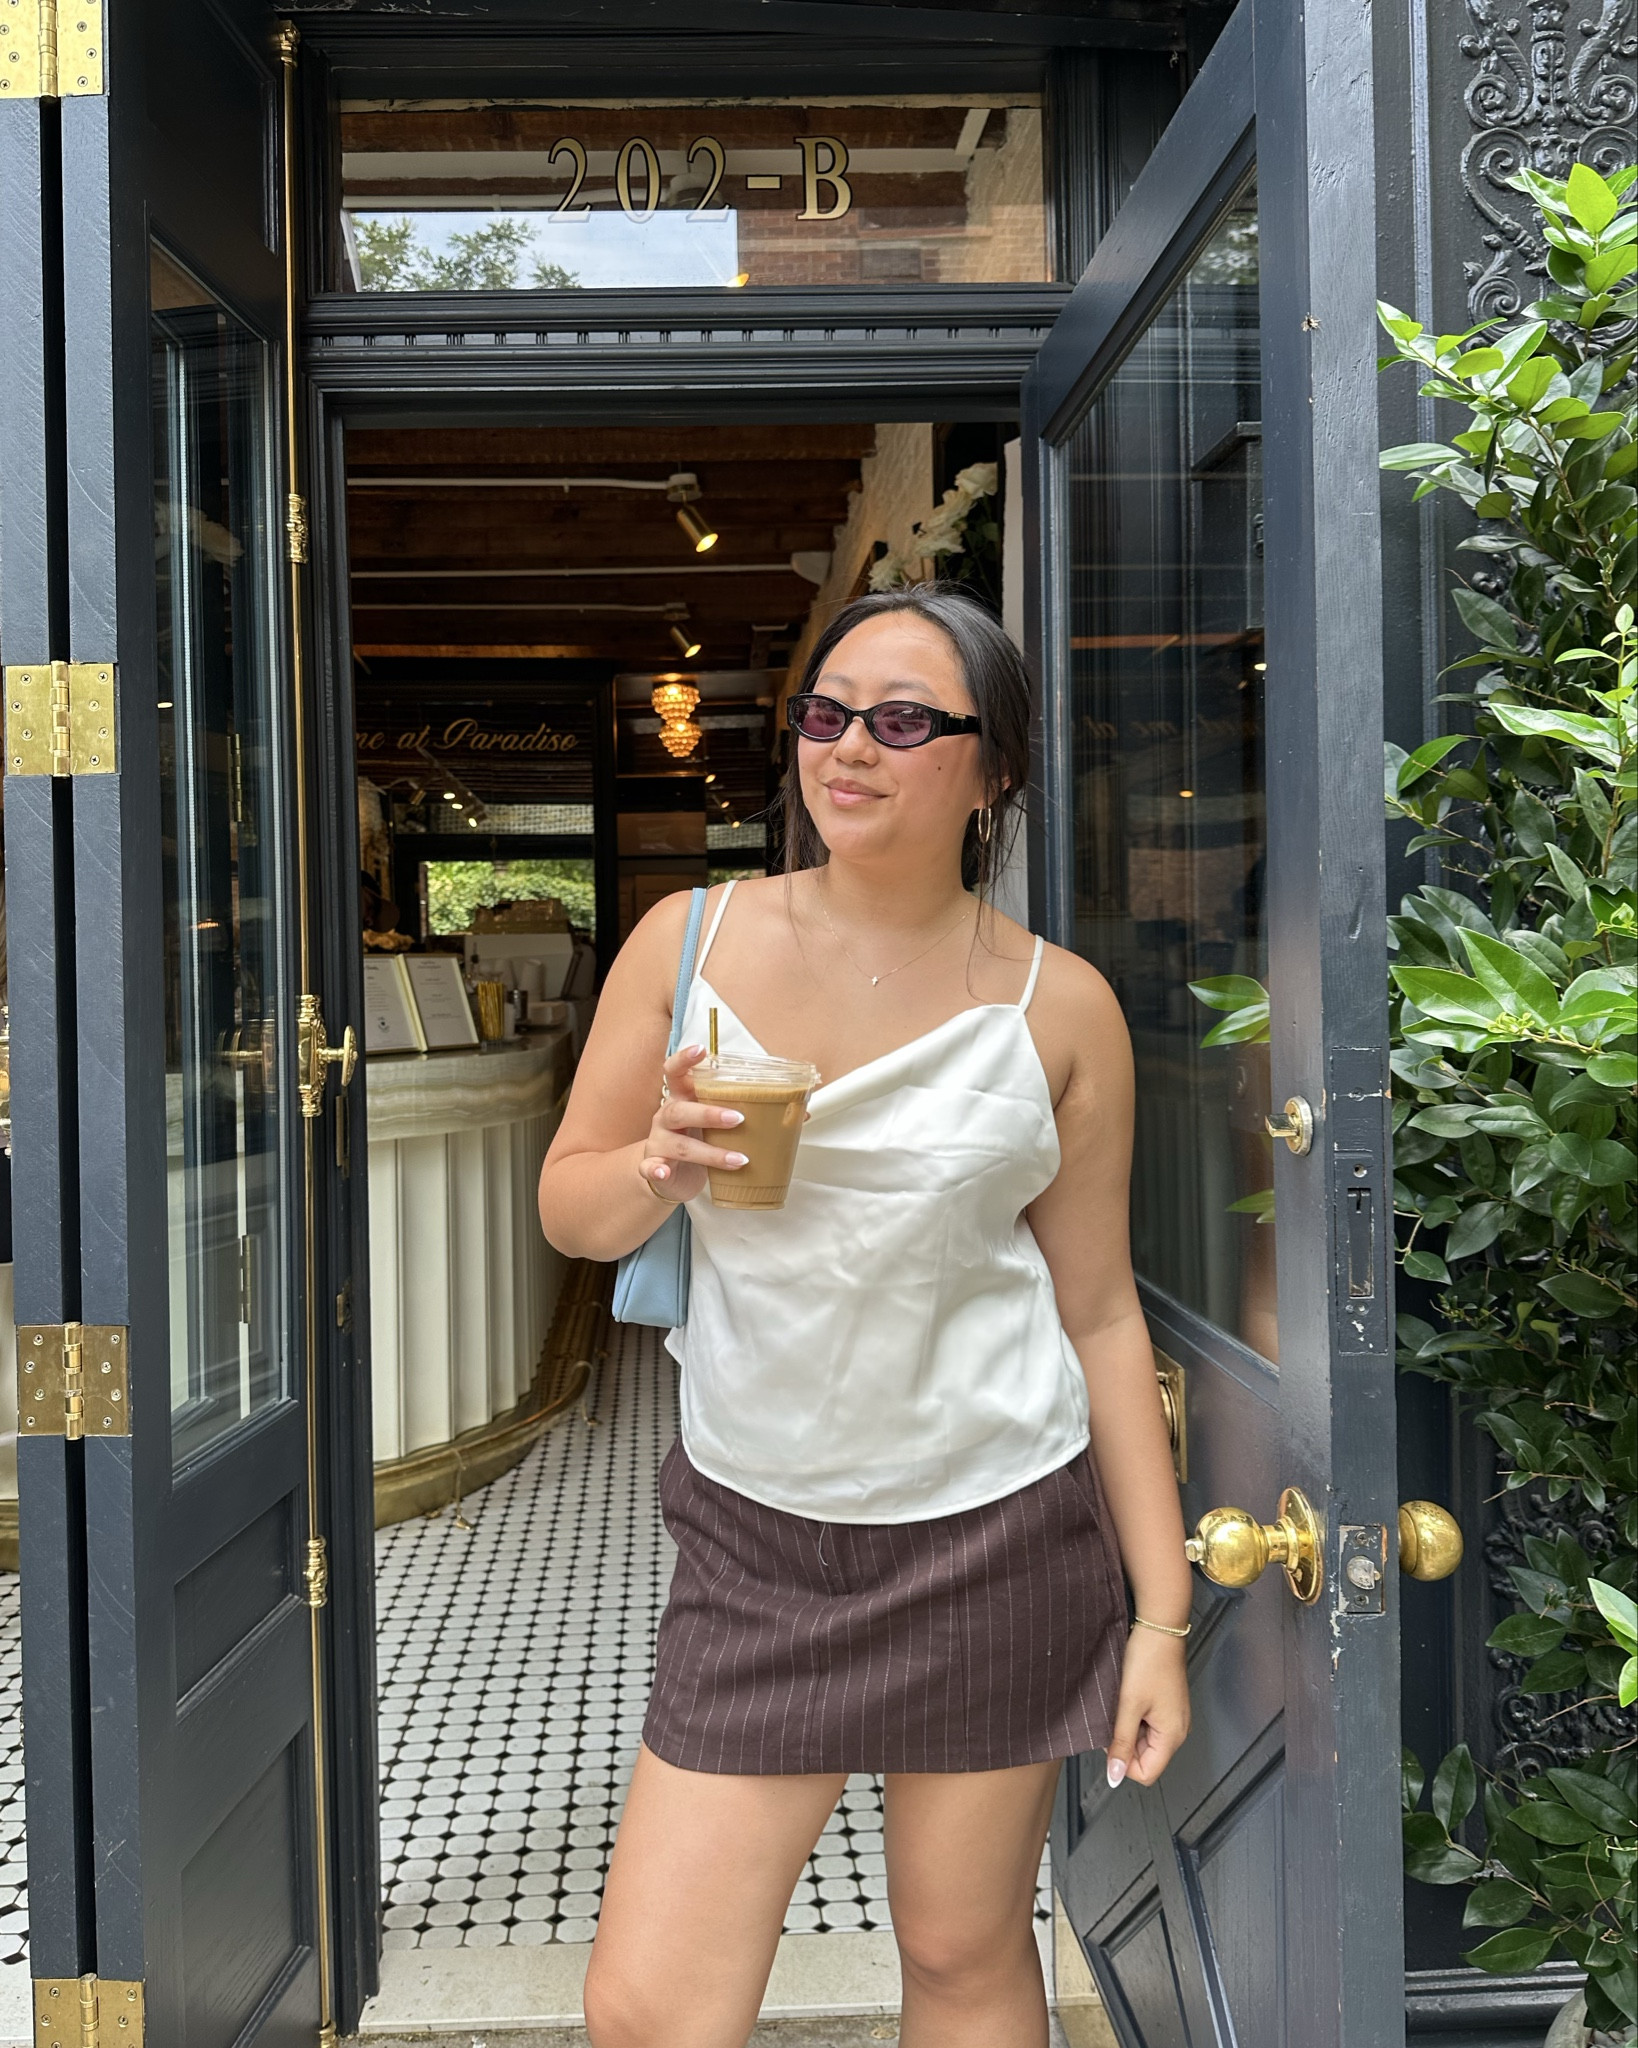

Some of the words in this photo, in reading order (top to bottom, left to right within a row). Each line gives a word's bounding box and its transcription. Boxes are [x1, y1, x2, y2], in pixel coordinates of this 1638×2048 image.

[547, 136, 853, 223] 202-B
[396, 725, 431, 750] at
[433, 718, 579, 751] Paradiso
